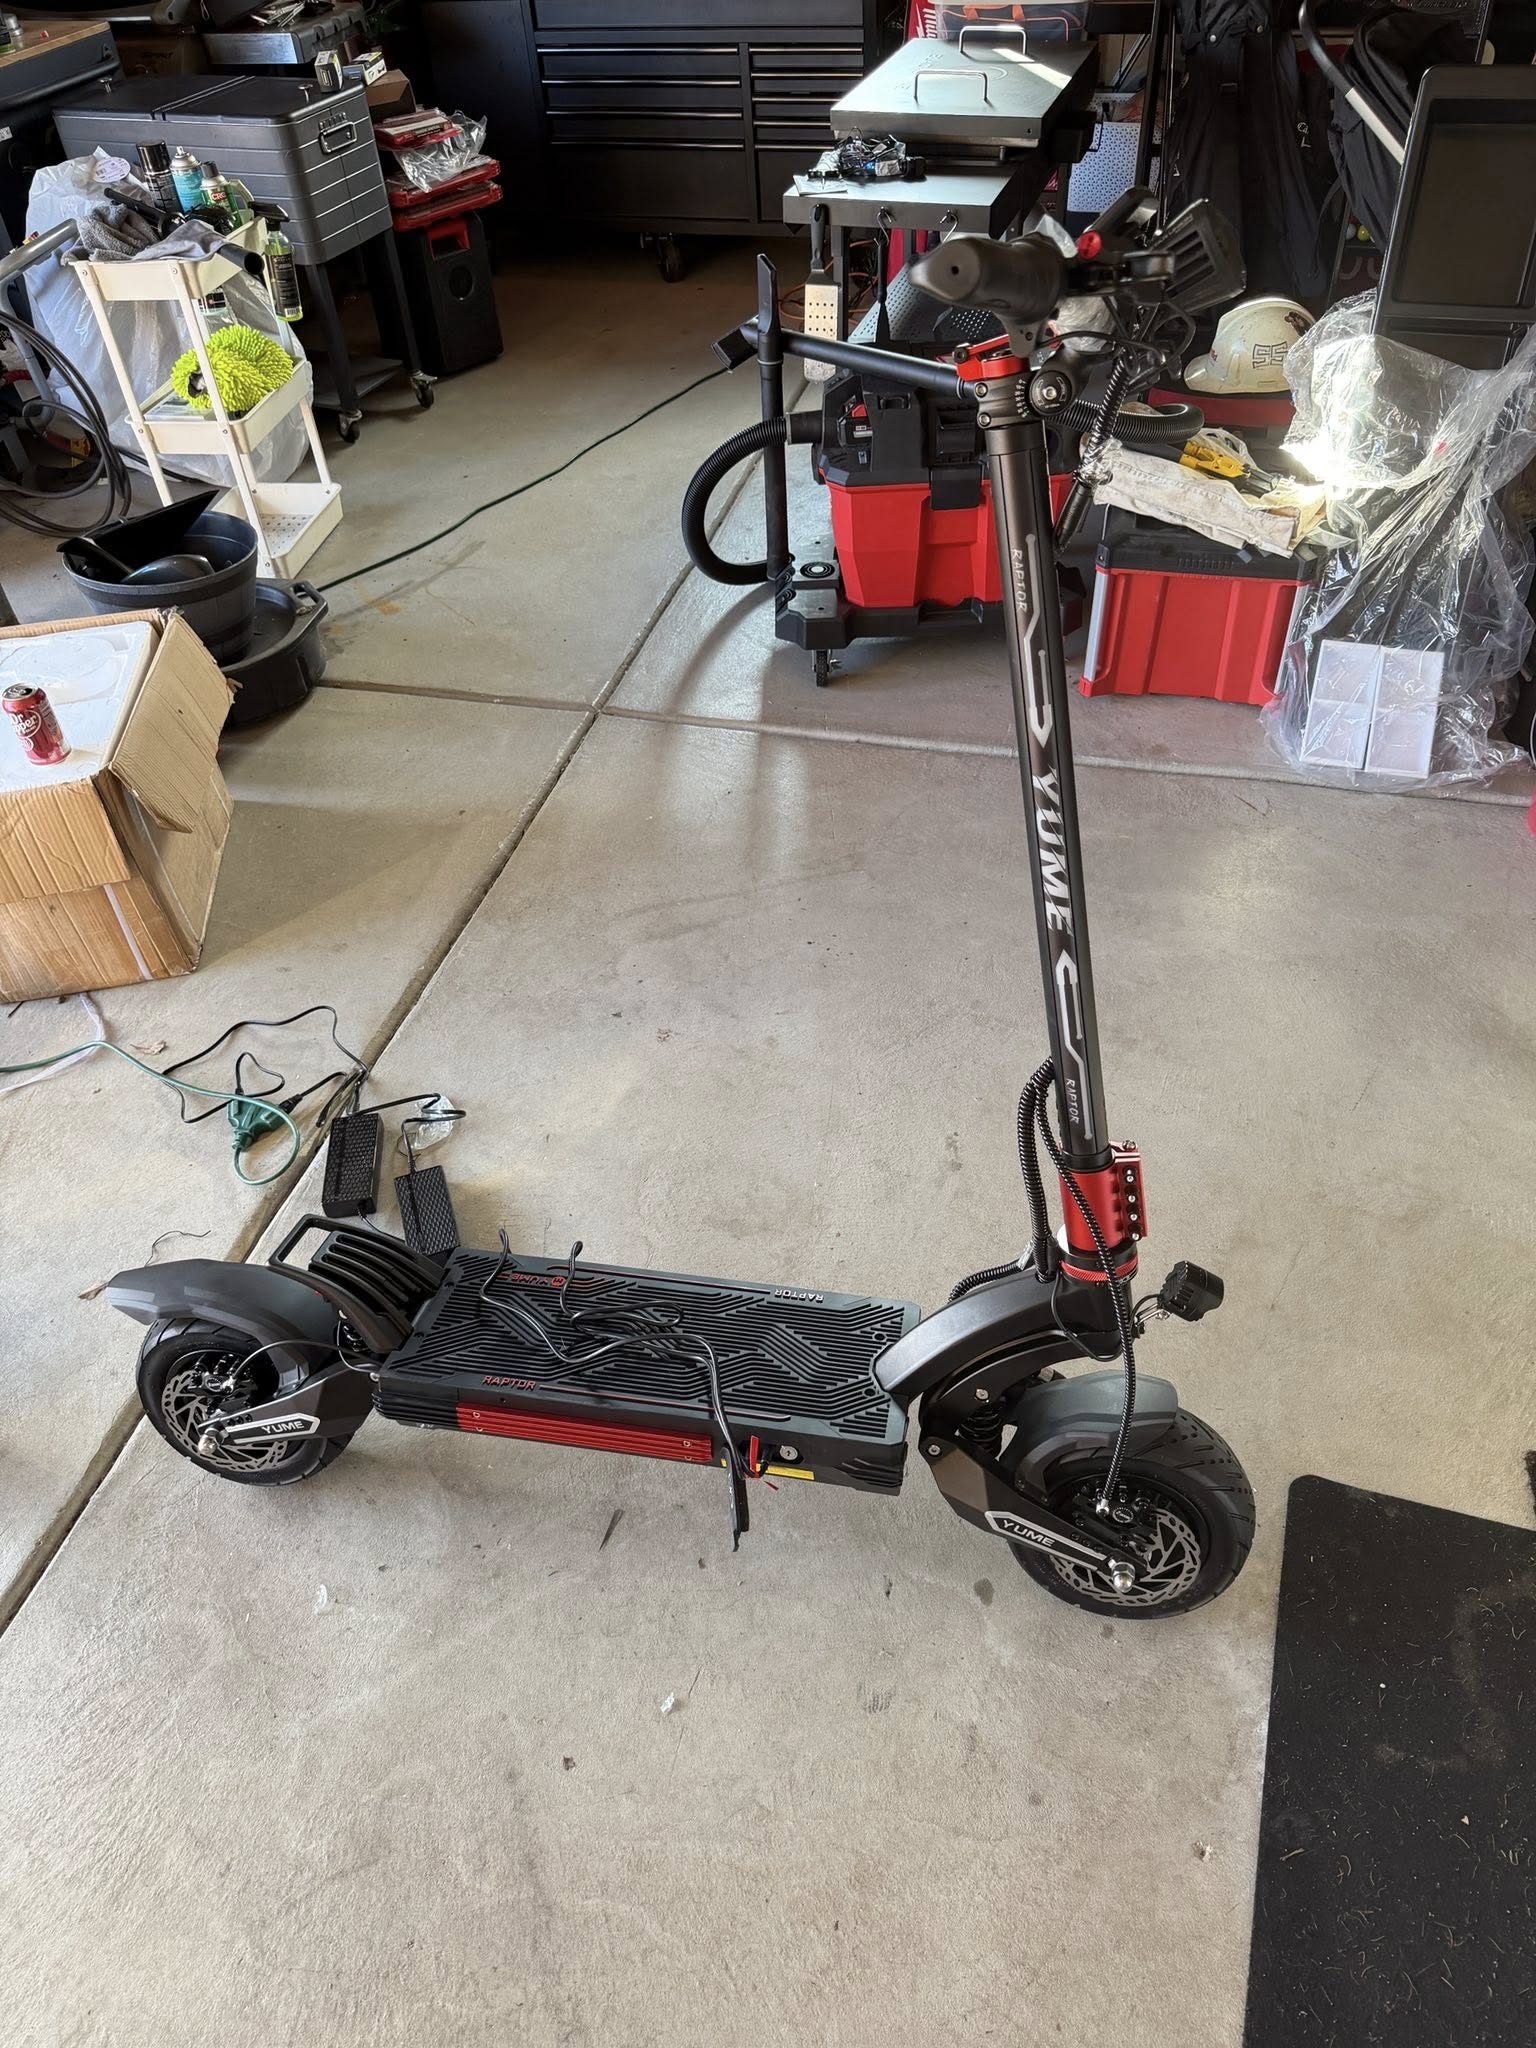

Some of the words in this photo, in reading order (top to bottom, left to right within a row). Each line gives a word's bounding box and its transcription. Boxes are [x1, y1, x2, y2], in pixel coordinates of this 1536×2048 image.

[1011, 548, 1028, 613] RAPTOR
[9, 713, 24, 725] Dr
[1032, 765, 1074, 937] YUME
[1065, 1078, 1080, 1124] RAPTOR
[512, 1273, 548, 1285] YUME
[774, 1288, 824, 1302] RAPTOR
[482, 1375, 536, 1390] RAPTOR
[261, 1420, 305, 1434] YUME
[1002, 1519, 1056, 1547] YUME
